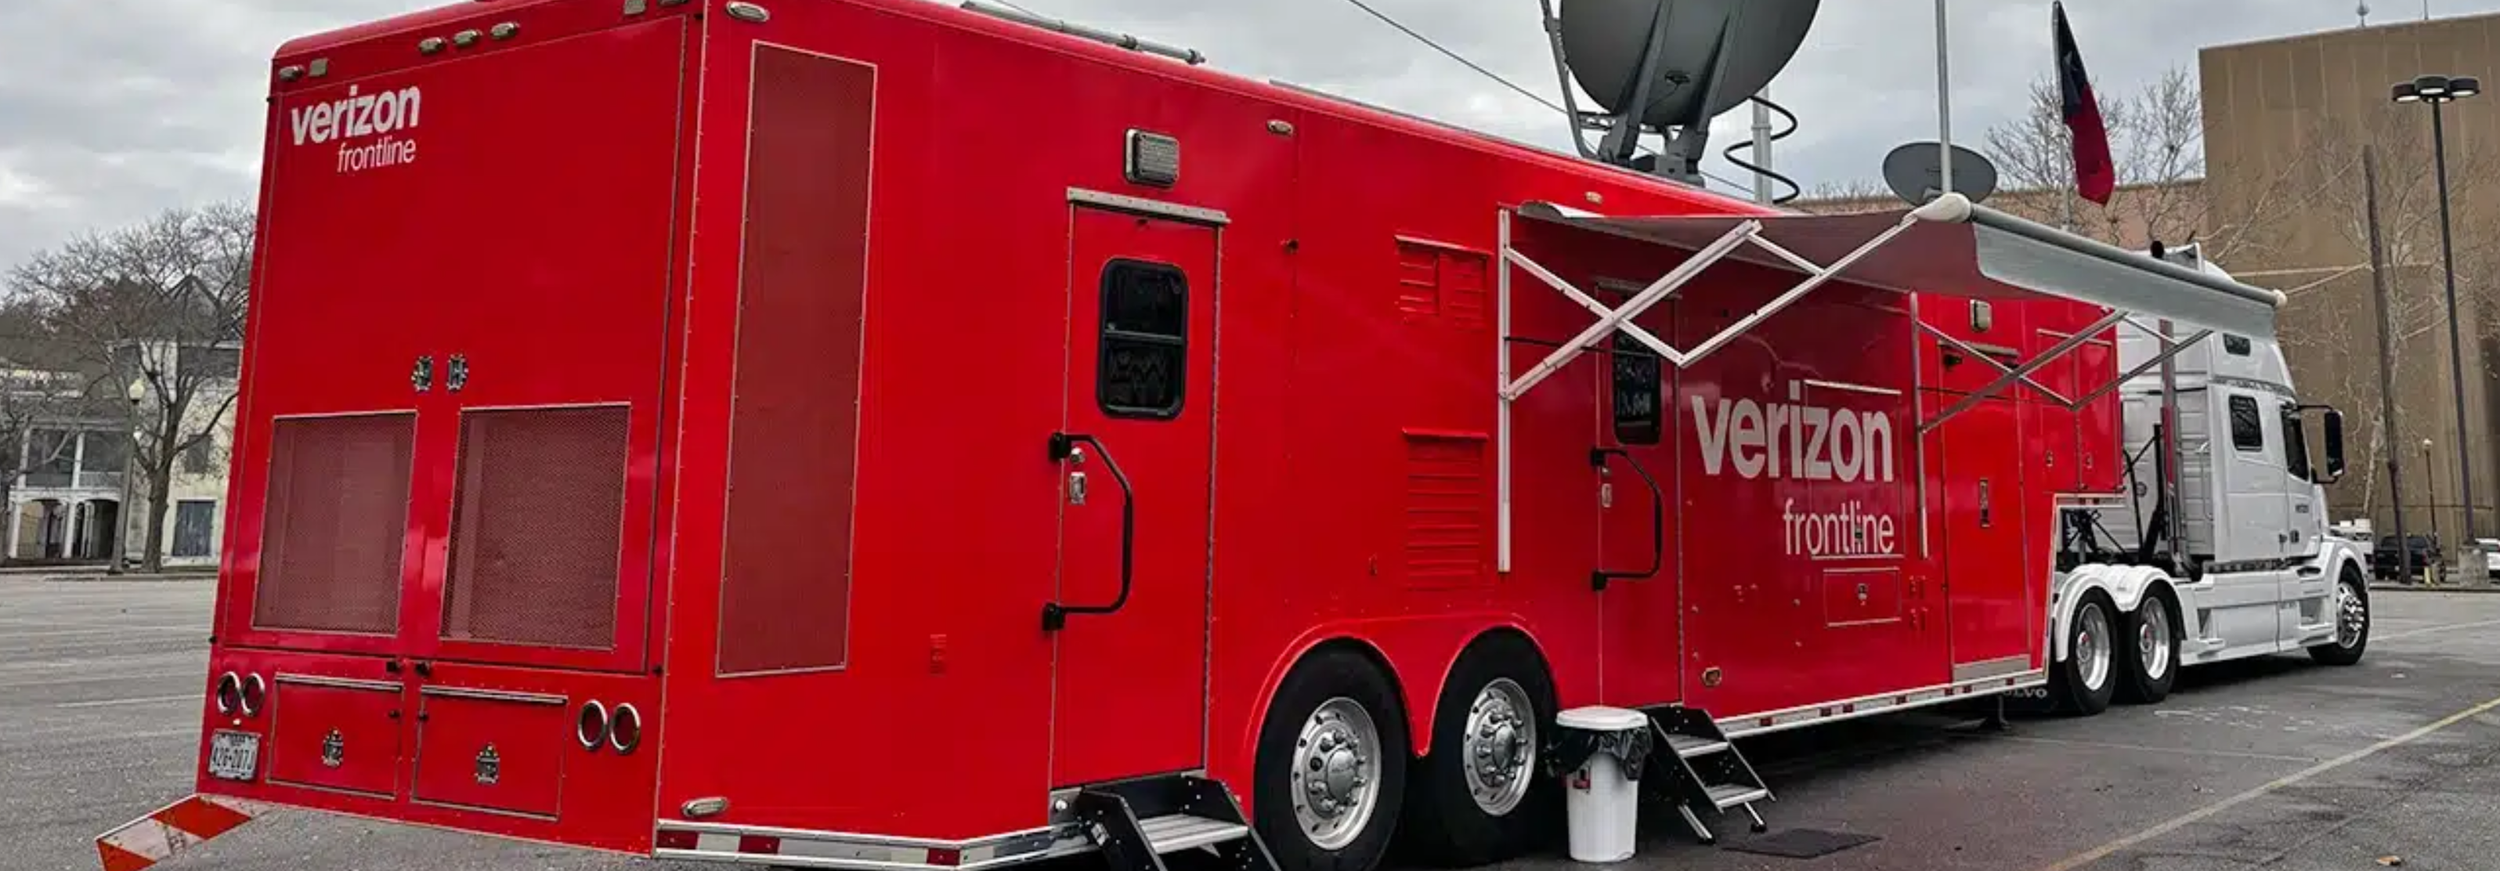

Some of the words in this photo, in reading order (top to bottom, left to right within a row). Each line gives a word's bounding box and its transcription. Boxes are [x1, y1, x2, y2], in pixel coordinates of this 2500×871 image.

[291, 84, 421, 146] verizon
[337, 135, 417, 173] frontline
[1691, 379, 1894, 483] verizon
[1782, 497, 1895, 555] frontline
[2002, 686, 2048, 698] OLVO
